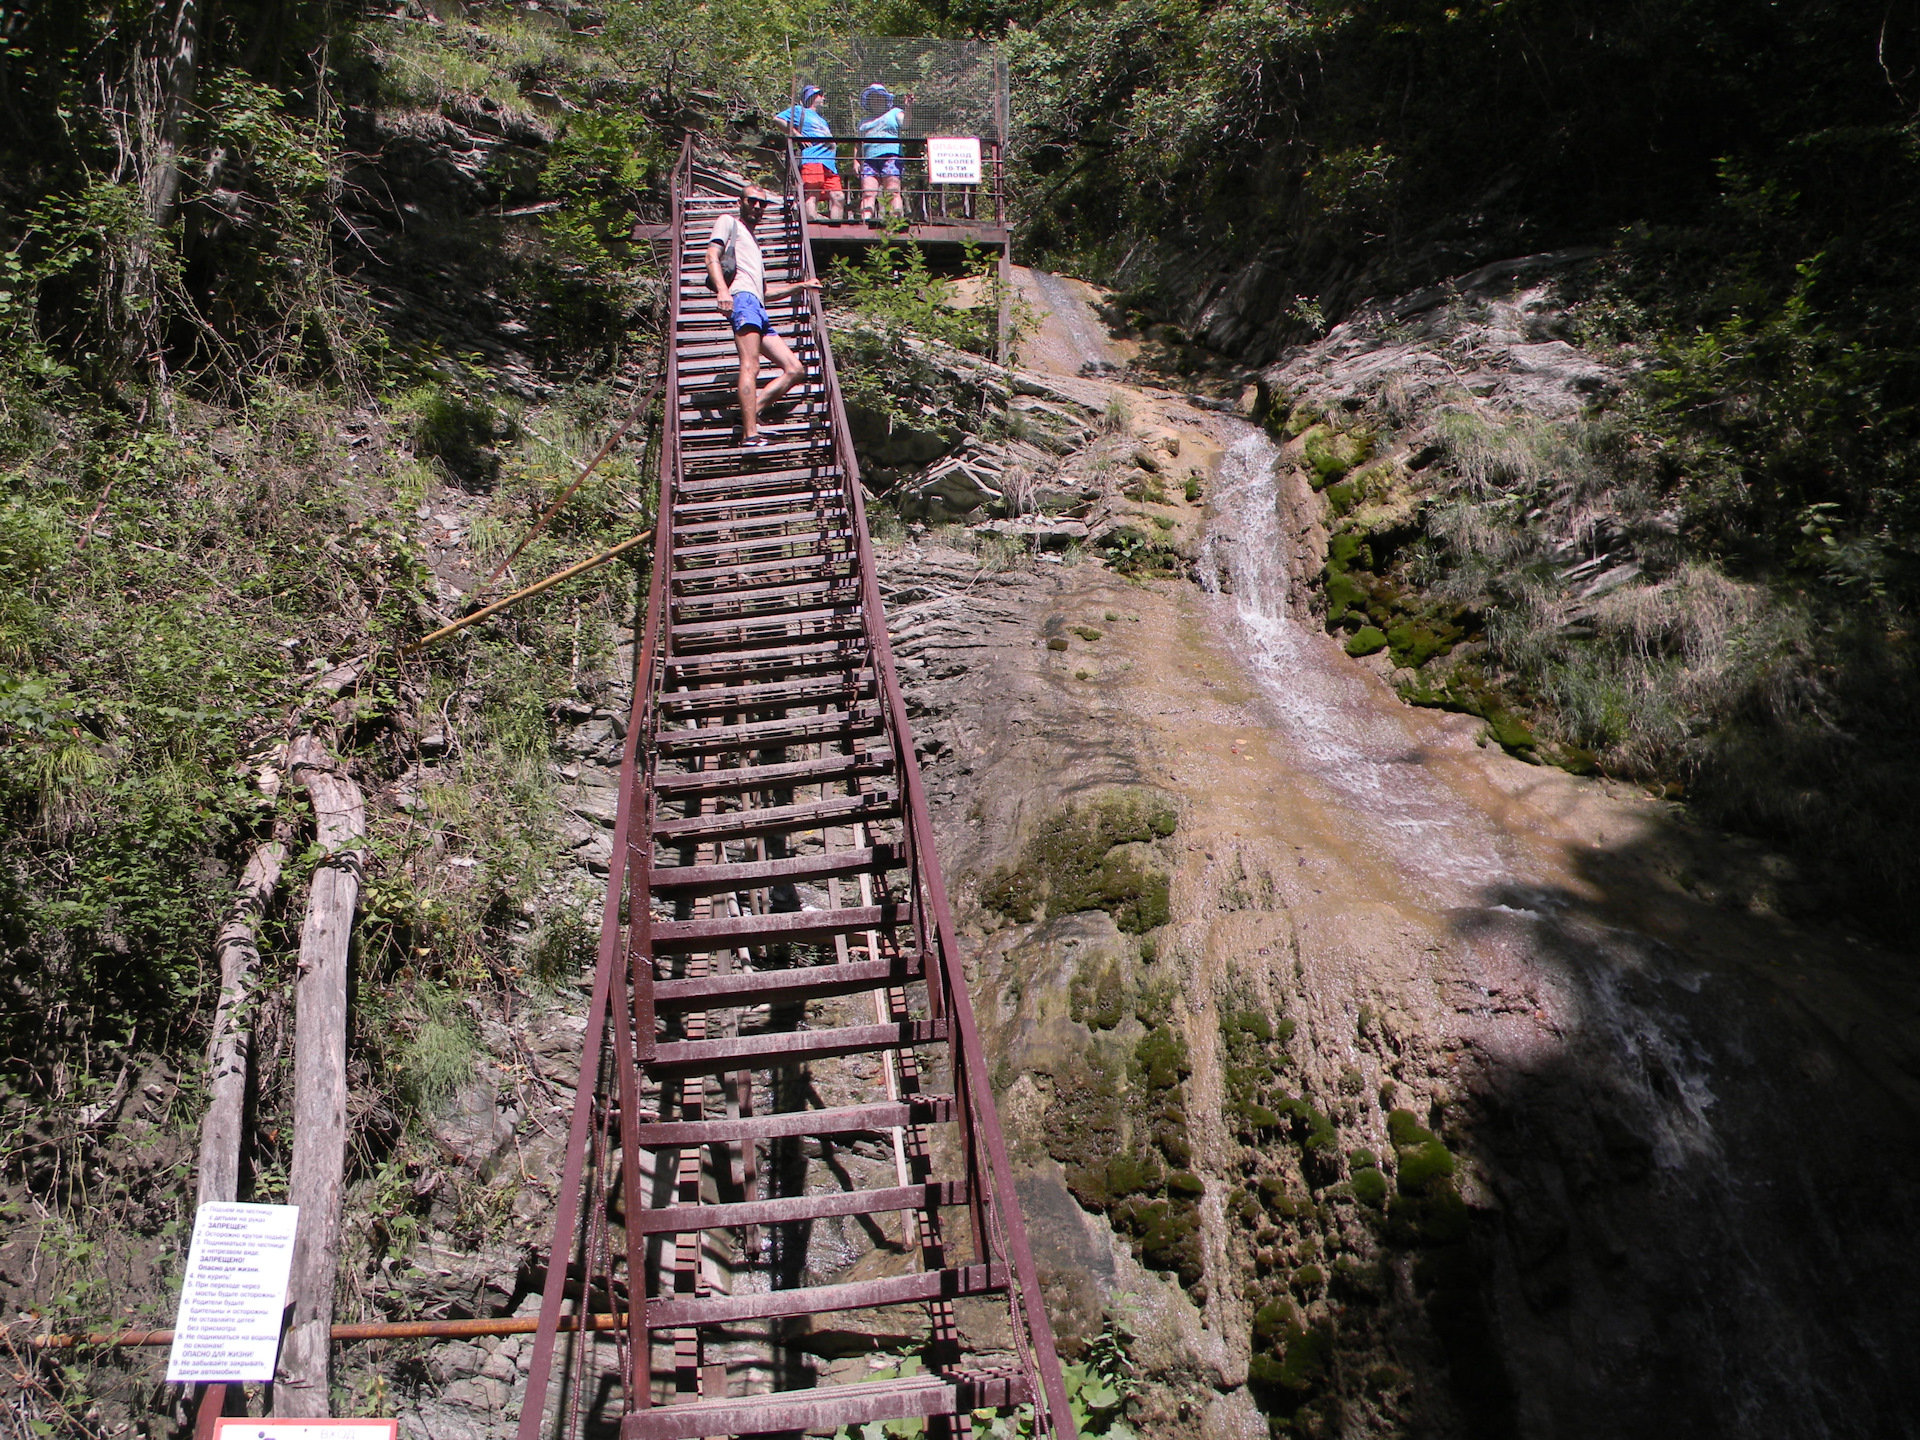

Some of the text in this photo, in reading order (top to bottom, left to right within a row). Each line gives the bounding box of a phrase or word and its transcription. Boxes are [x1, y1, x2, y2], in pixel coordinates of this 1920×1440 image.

[207, 1222, 248, 1230] ЗАПРЕЩЕН!
[205, 1230, 241, 1239] Осторожно
[204, 1239, 247, 1248] Подниматься
[199, 1256, 245, 1264] ЗАПРЕЩЕНО!
[218, 1290, 238, 1298] будьте
[224, 1298, 245, 1306] будьте
[229, 1360, 264, 1368] закрывать
[320, 1429, 356, 1439] ВХОД
